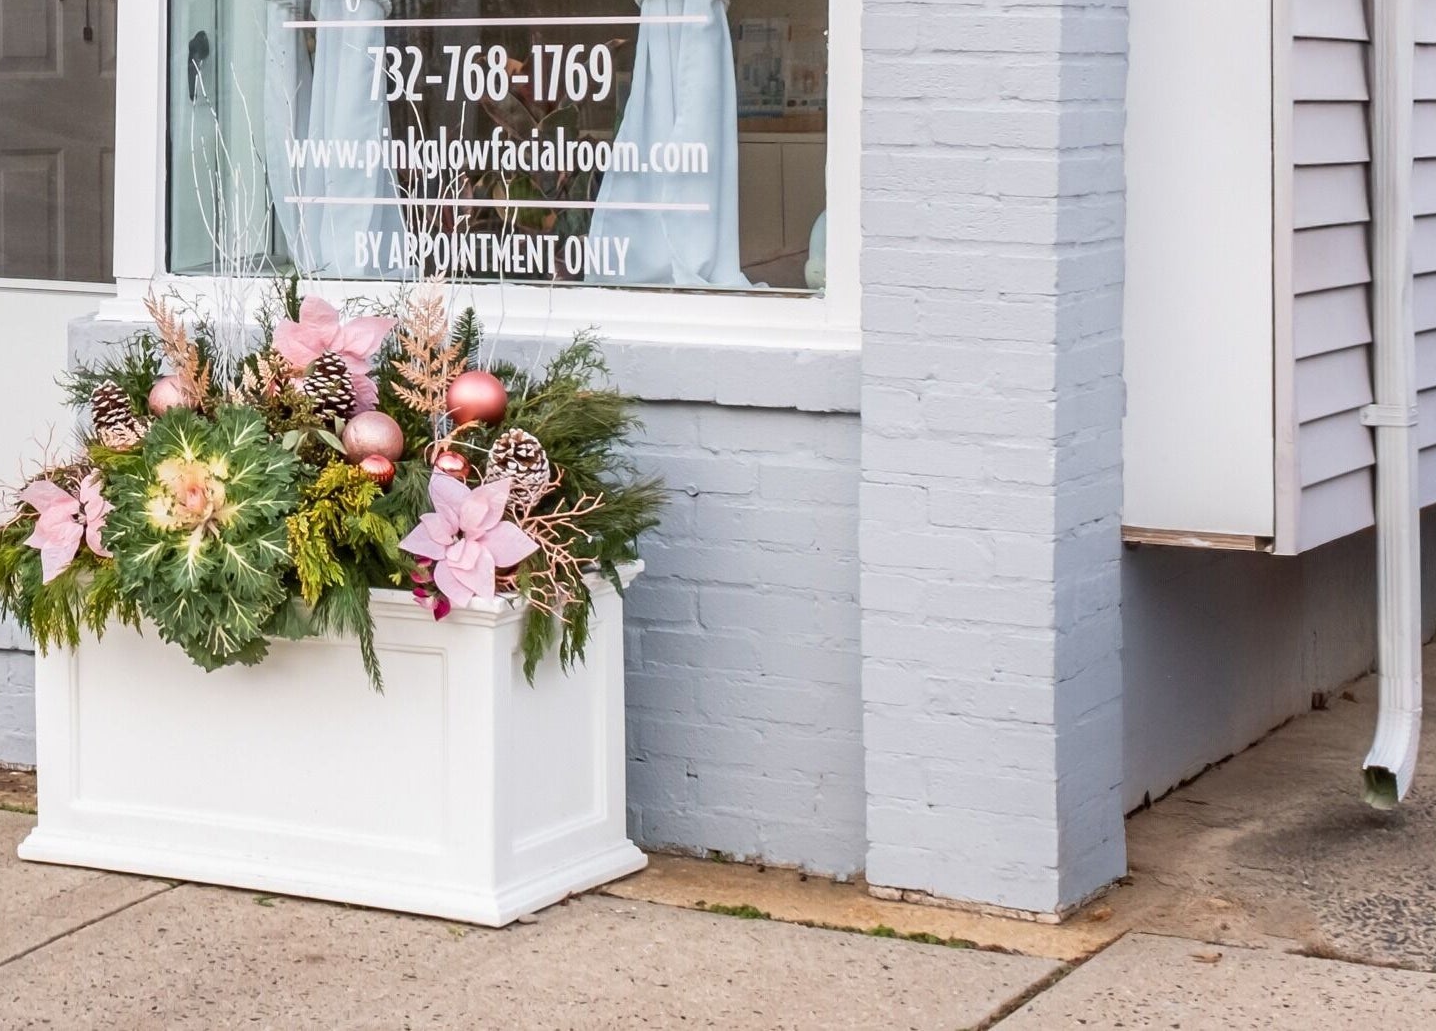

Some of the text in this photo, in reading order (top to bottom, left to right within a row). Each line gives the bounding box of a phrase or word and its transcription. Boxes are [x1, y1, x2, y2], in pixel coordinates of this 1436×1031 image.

[366, 43, 613, 104] 732-768-1769
[284, 125, 709, 179] www.pinkglowfacialroom.com
[354, 230, 630, 276] BY APPOINTMENT ONLY
